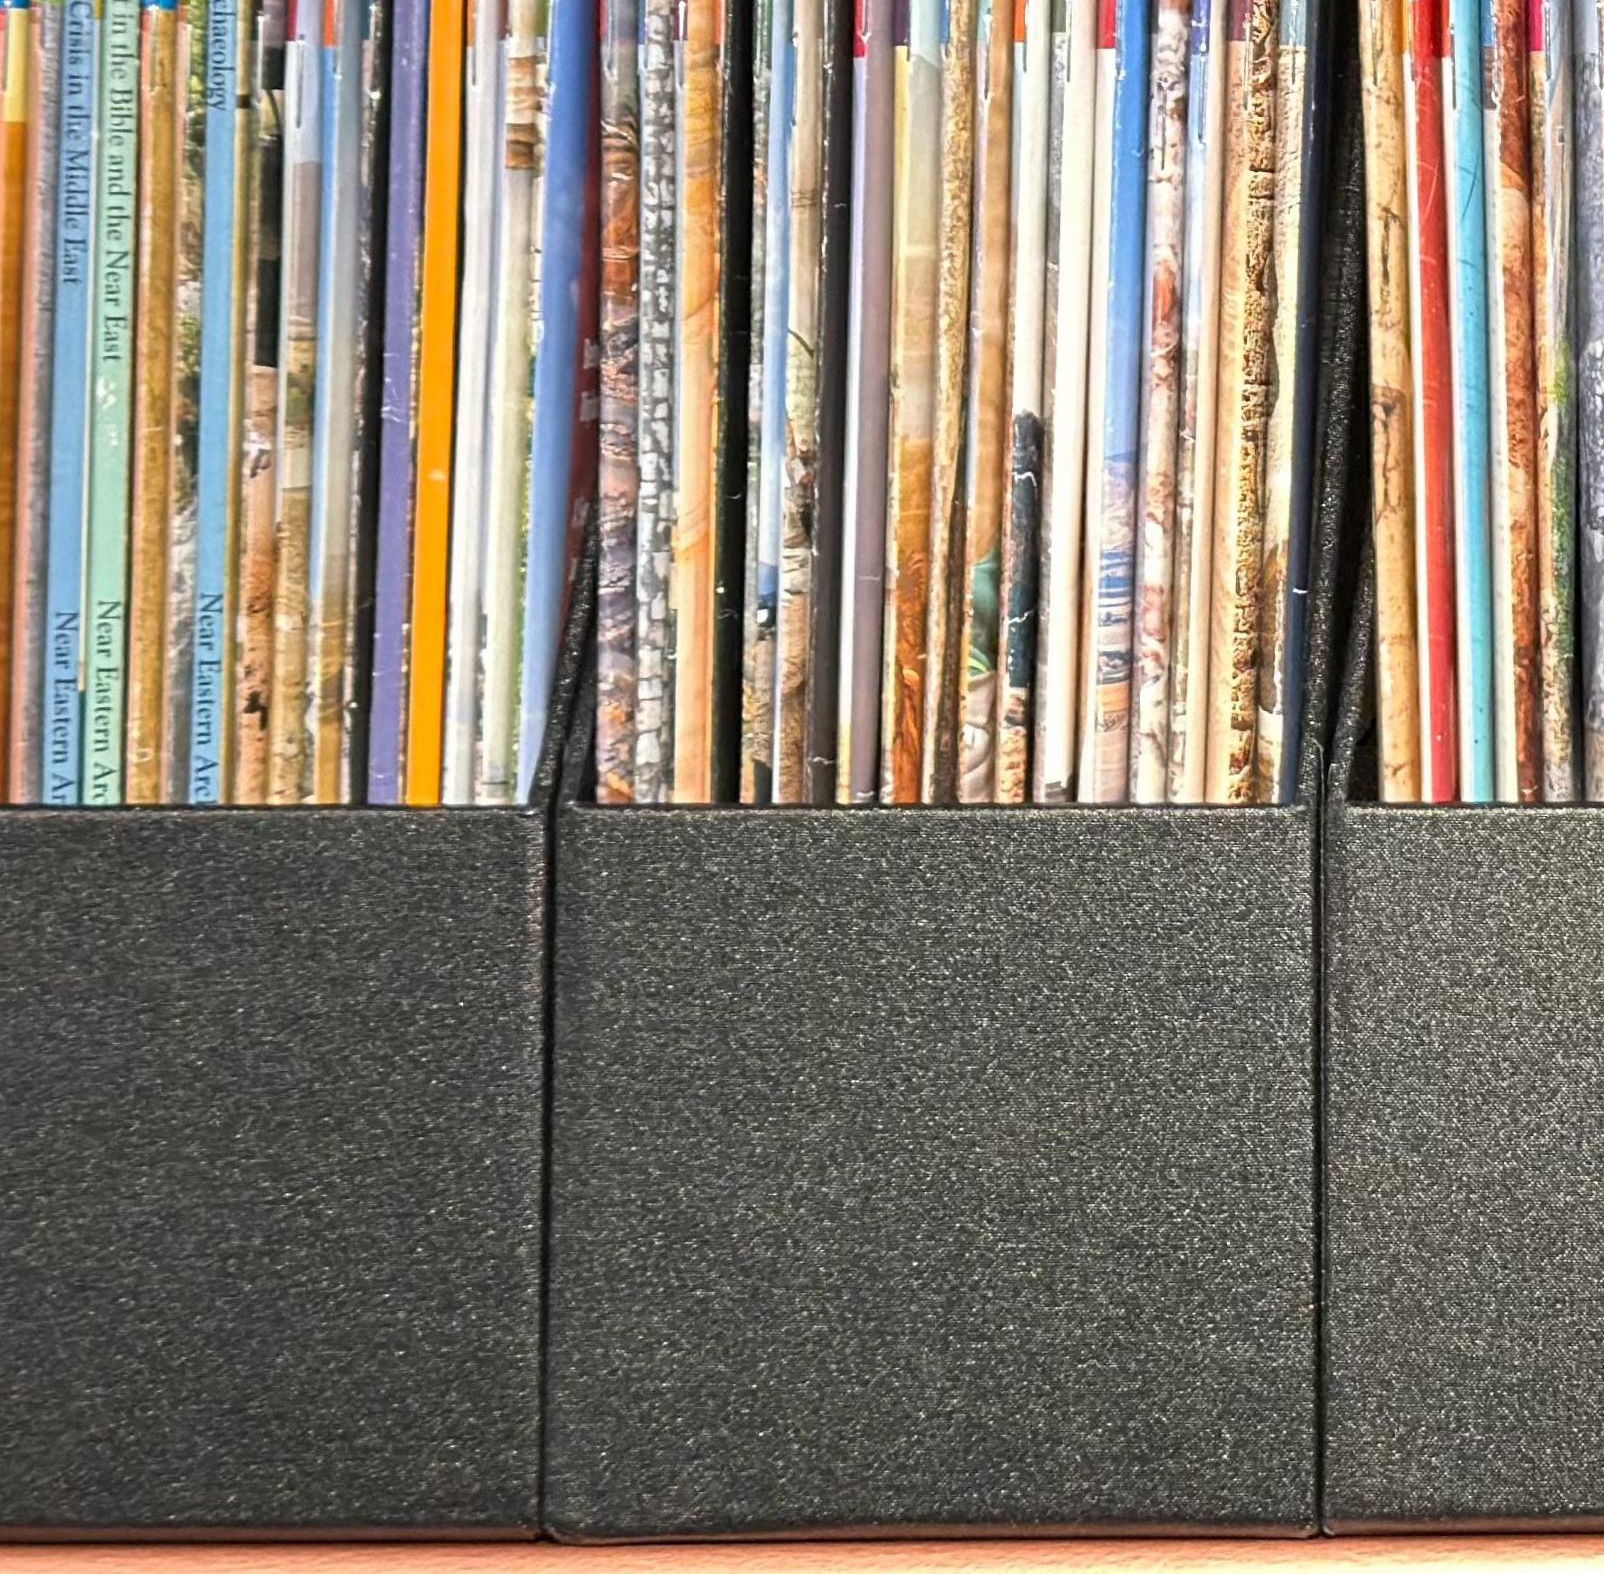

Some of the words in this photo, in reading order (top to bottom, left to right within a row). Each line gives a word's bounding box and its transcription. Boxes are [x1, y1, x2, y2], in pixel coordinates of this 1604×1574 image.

[67, 0, 91, 64] Crisis
[110, 14, 134, 34] in
[67, 74, 90, 94] in
[109, 44, 135, 79] the
[66, 105, 90, 140] the
[108, 88, 134, 146] Bible
[64, 150, 90, 230] Middle
[107, 155, 132, 195] and
[106, 205, 132, 240] the
[62, 238, 87, 285] East
[104, 250, 130, 306] Near
[103, 315, 129, 361] East
[54, 612, 79, 670] Near
[96, 601, 122, 658] Near
[198, 593, 224, 651] Near
[52, 678, 78, 764] Eastern
[94, 667, 120, 753] Eastern
[196, 660, 222, 746] Eastern
